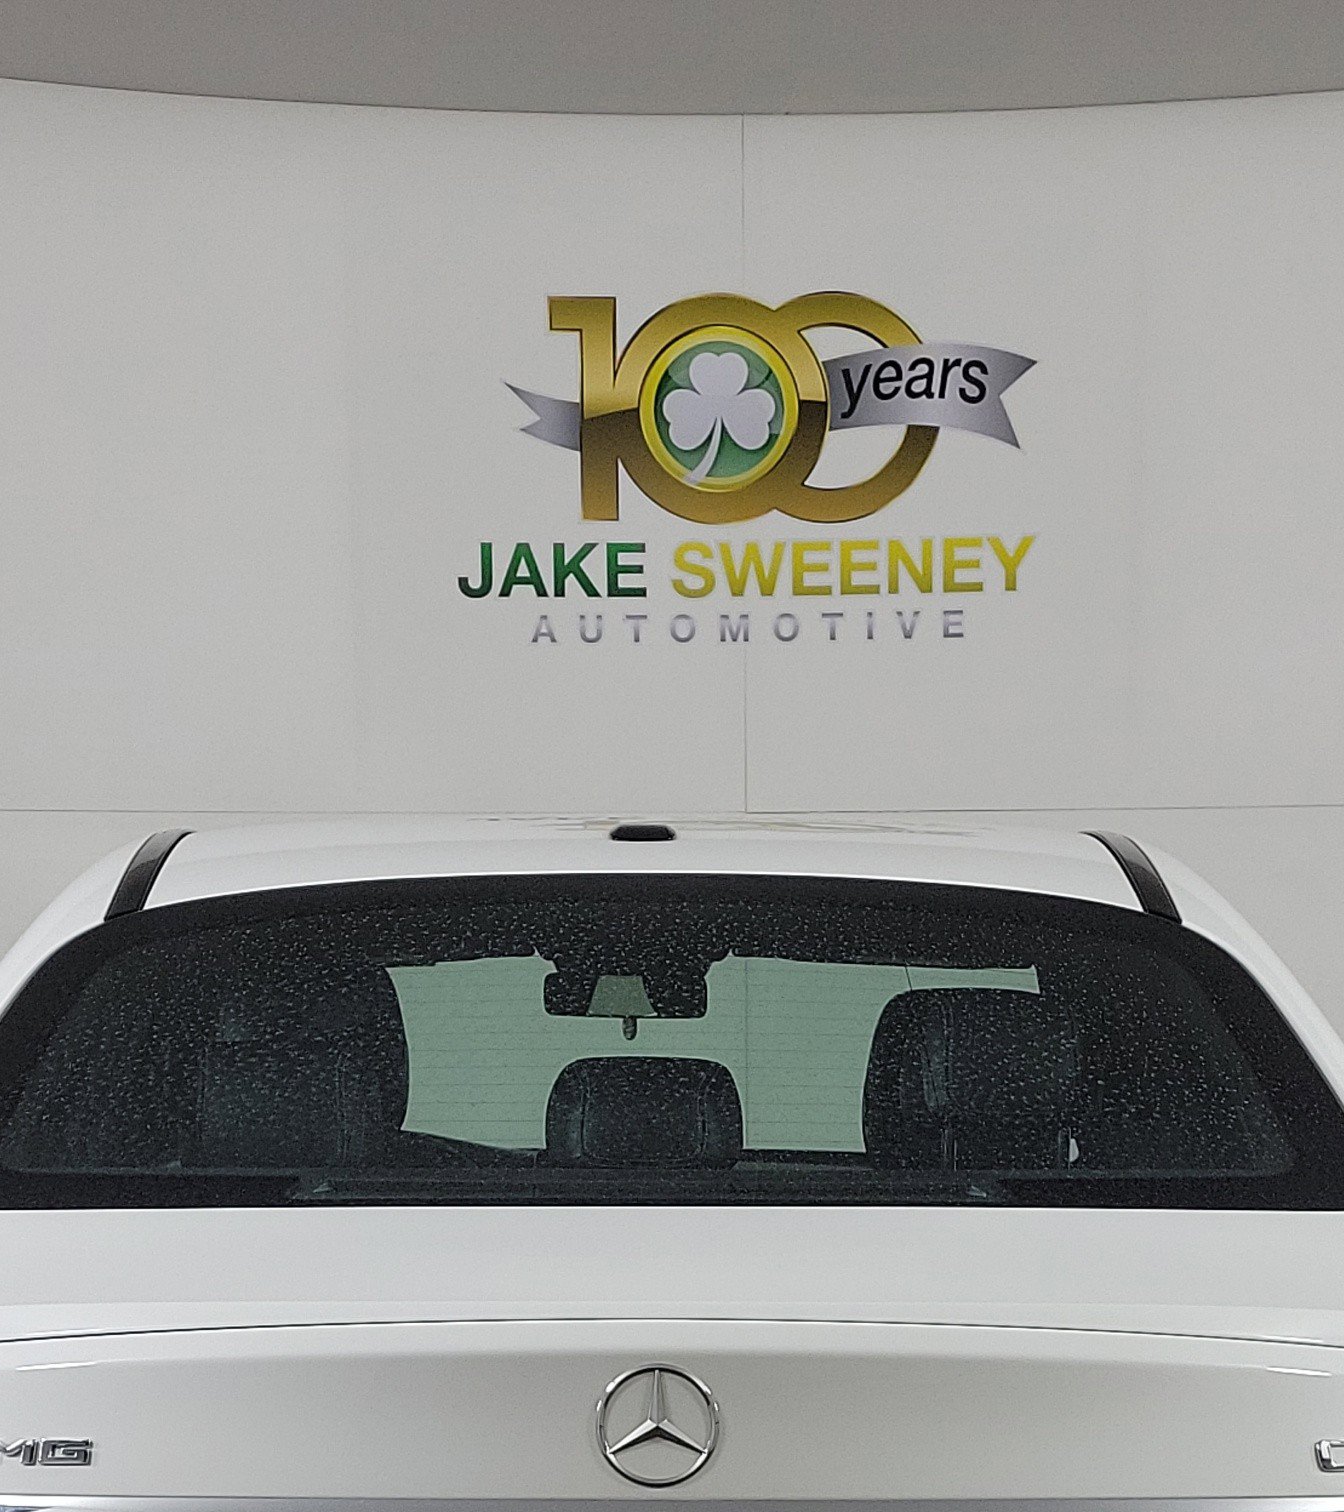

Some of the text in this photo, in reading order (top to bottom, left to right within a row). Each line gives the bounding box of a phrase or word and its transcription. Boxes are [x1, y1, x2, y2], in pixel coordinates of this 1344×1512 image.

[546, 290, 989, 524] 100 years
[457, 534, 1036, 599] JAKE SWEENEY
[530, 609, 965, 644] AUTOMOTIVE
